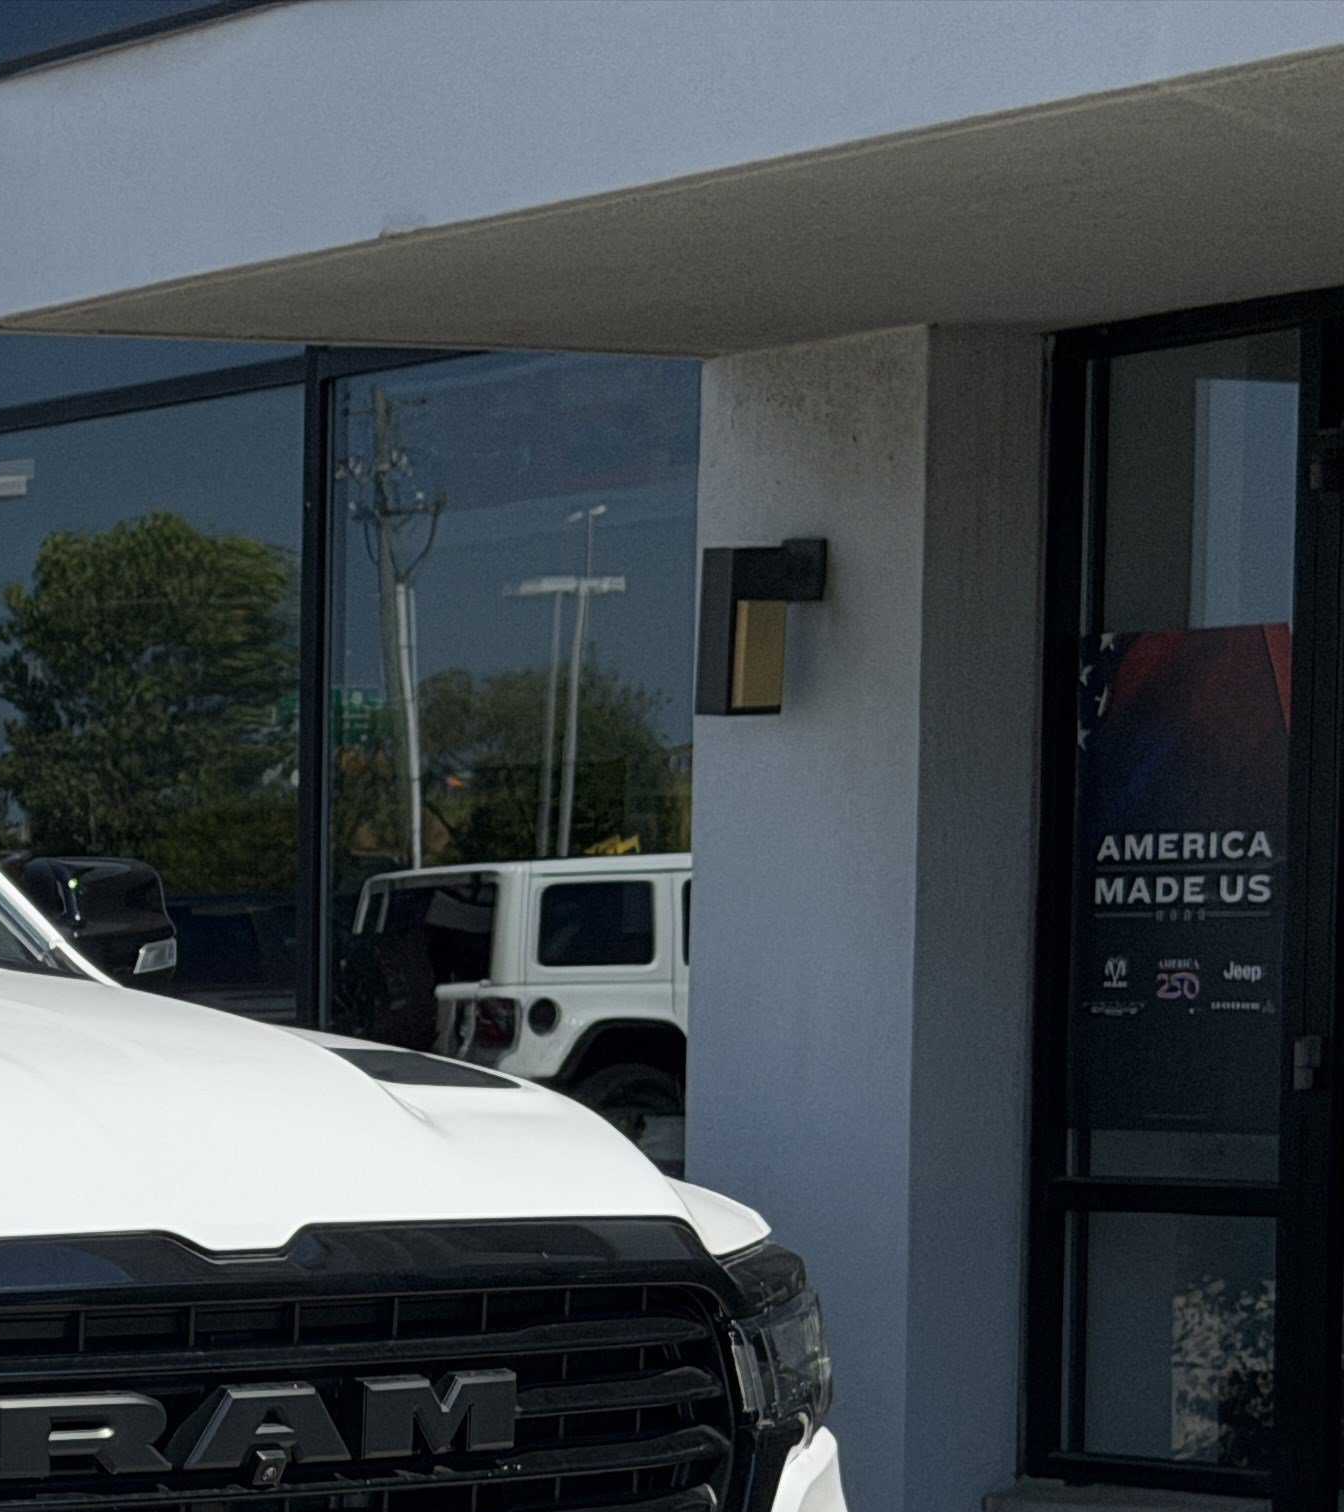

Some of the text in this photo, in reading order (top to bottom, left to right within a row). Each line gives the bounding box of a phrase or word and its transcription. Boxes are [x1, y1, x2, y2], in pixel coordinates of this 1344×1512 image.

[1096, 831, 1272, 862] AMERICA
[1094, 875, 1272, 905] MADE US
[1223, 961, 1262, 982] Jeep
